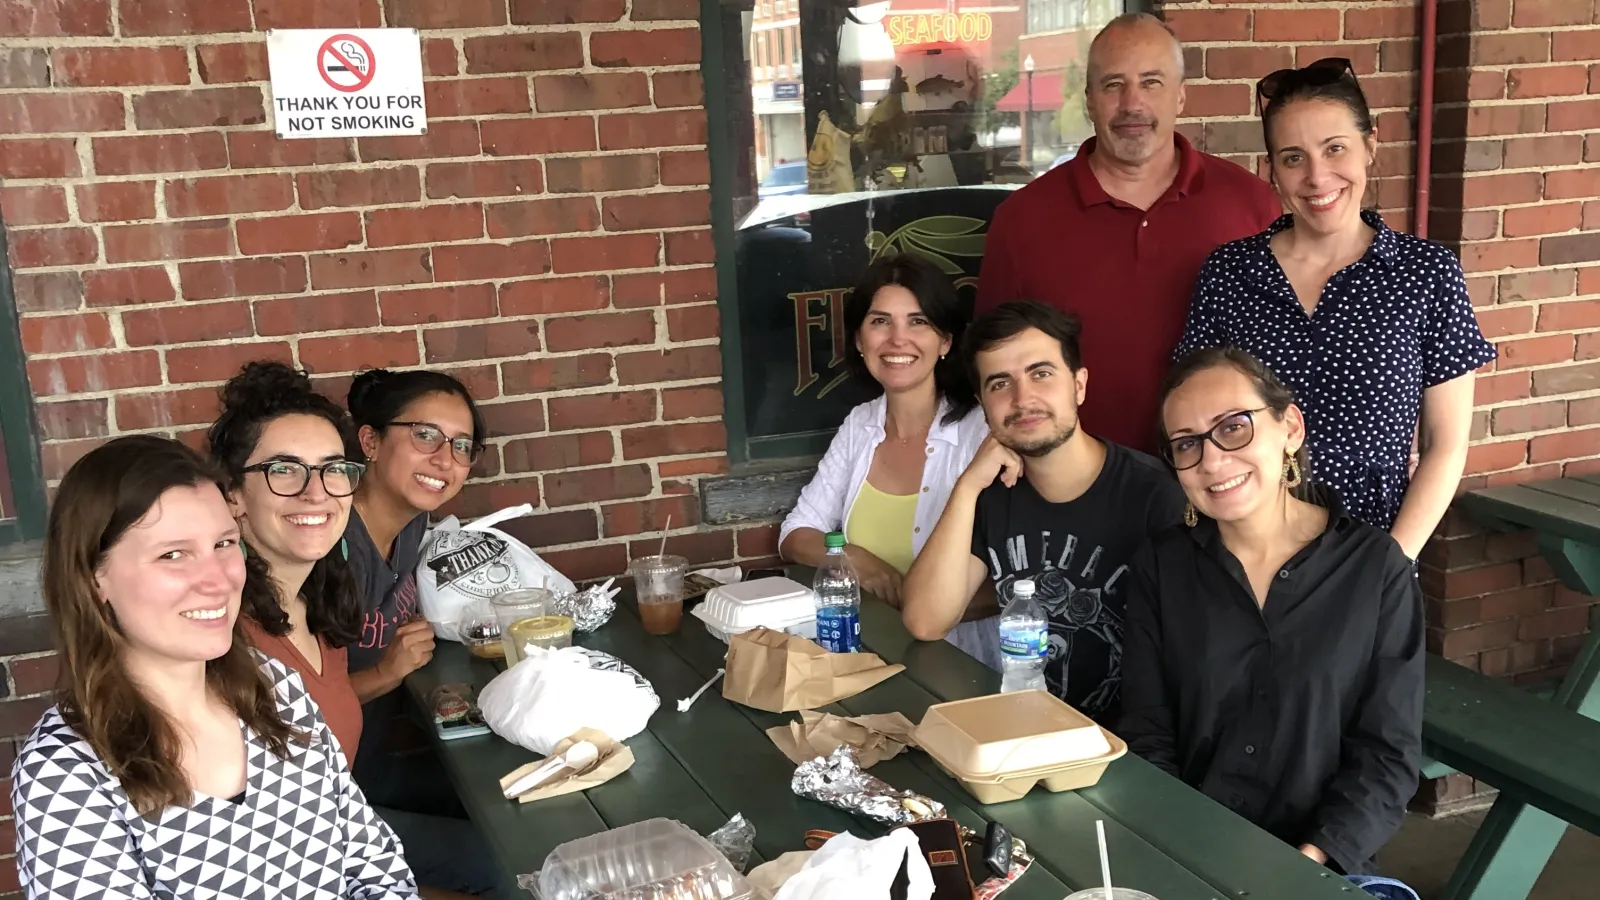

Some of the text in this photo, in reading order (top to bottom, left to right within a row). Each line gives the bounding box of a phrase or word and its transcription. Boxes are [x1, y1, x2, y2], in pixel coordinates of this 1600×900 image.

[889, 12, 992, 46] SEAFOOD
[276, 95, 423, 112] THANK YOU FOR
[288, 115, 414, 132] NOT SMOKING
[447, 541, 495, 575] THANK
